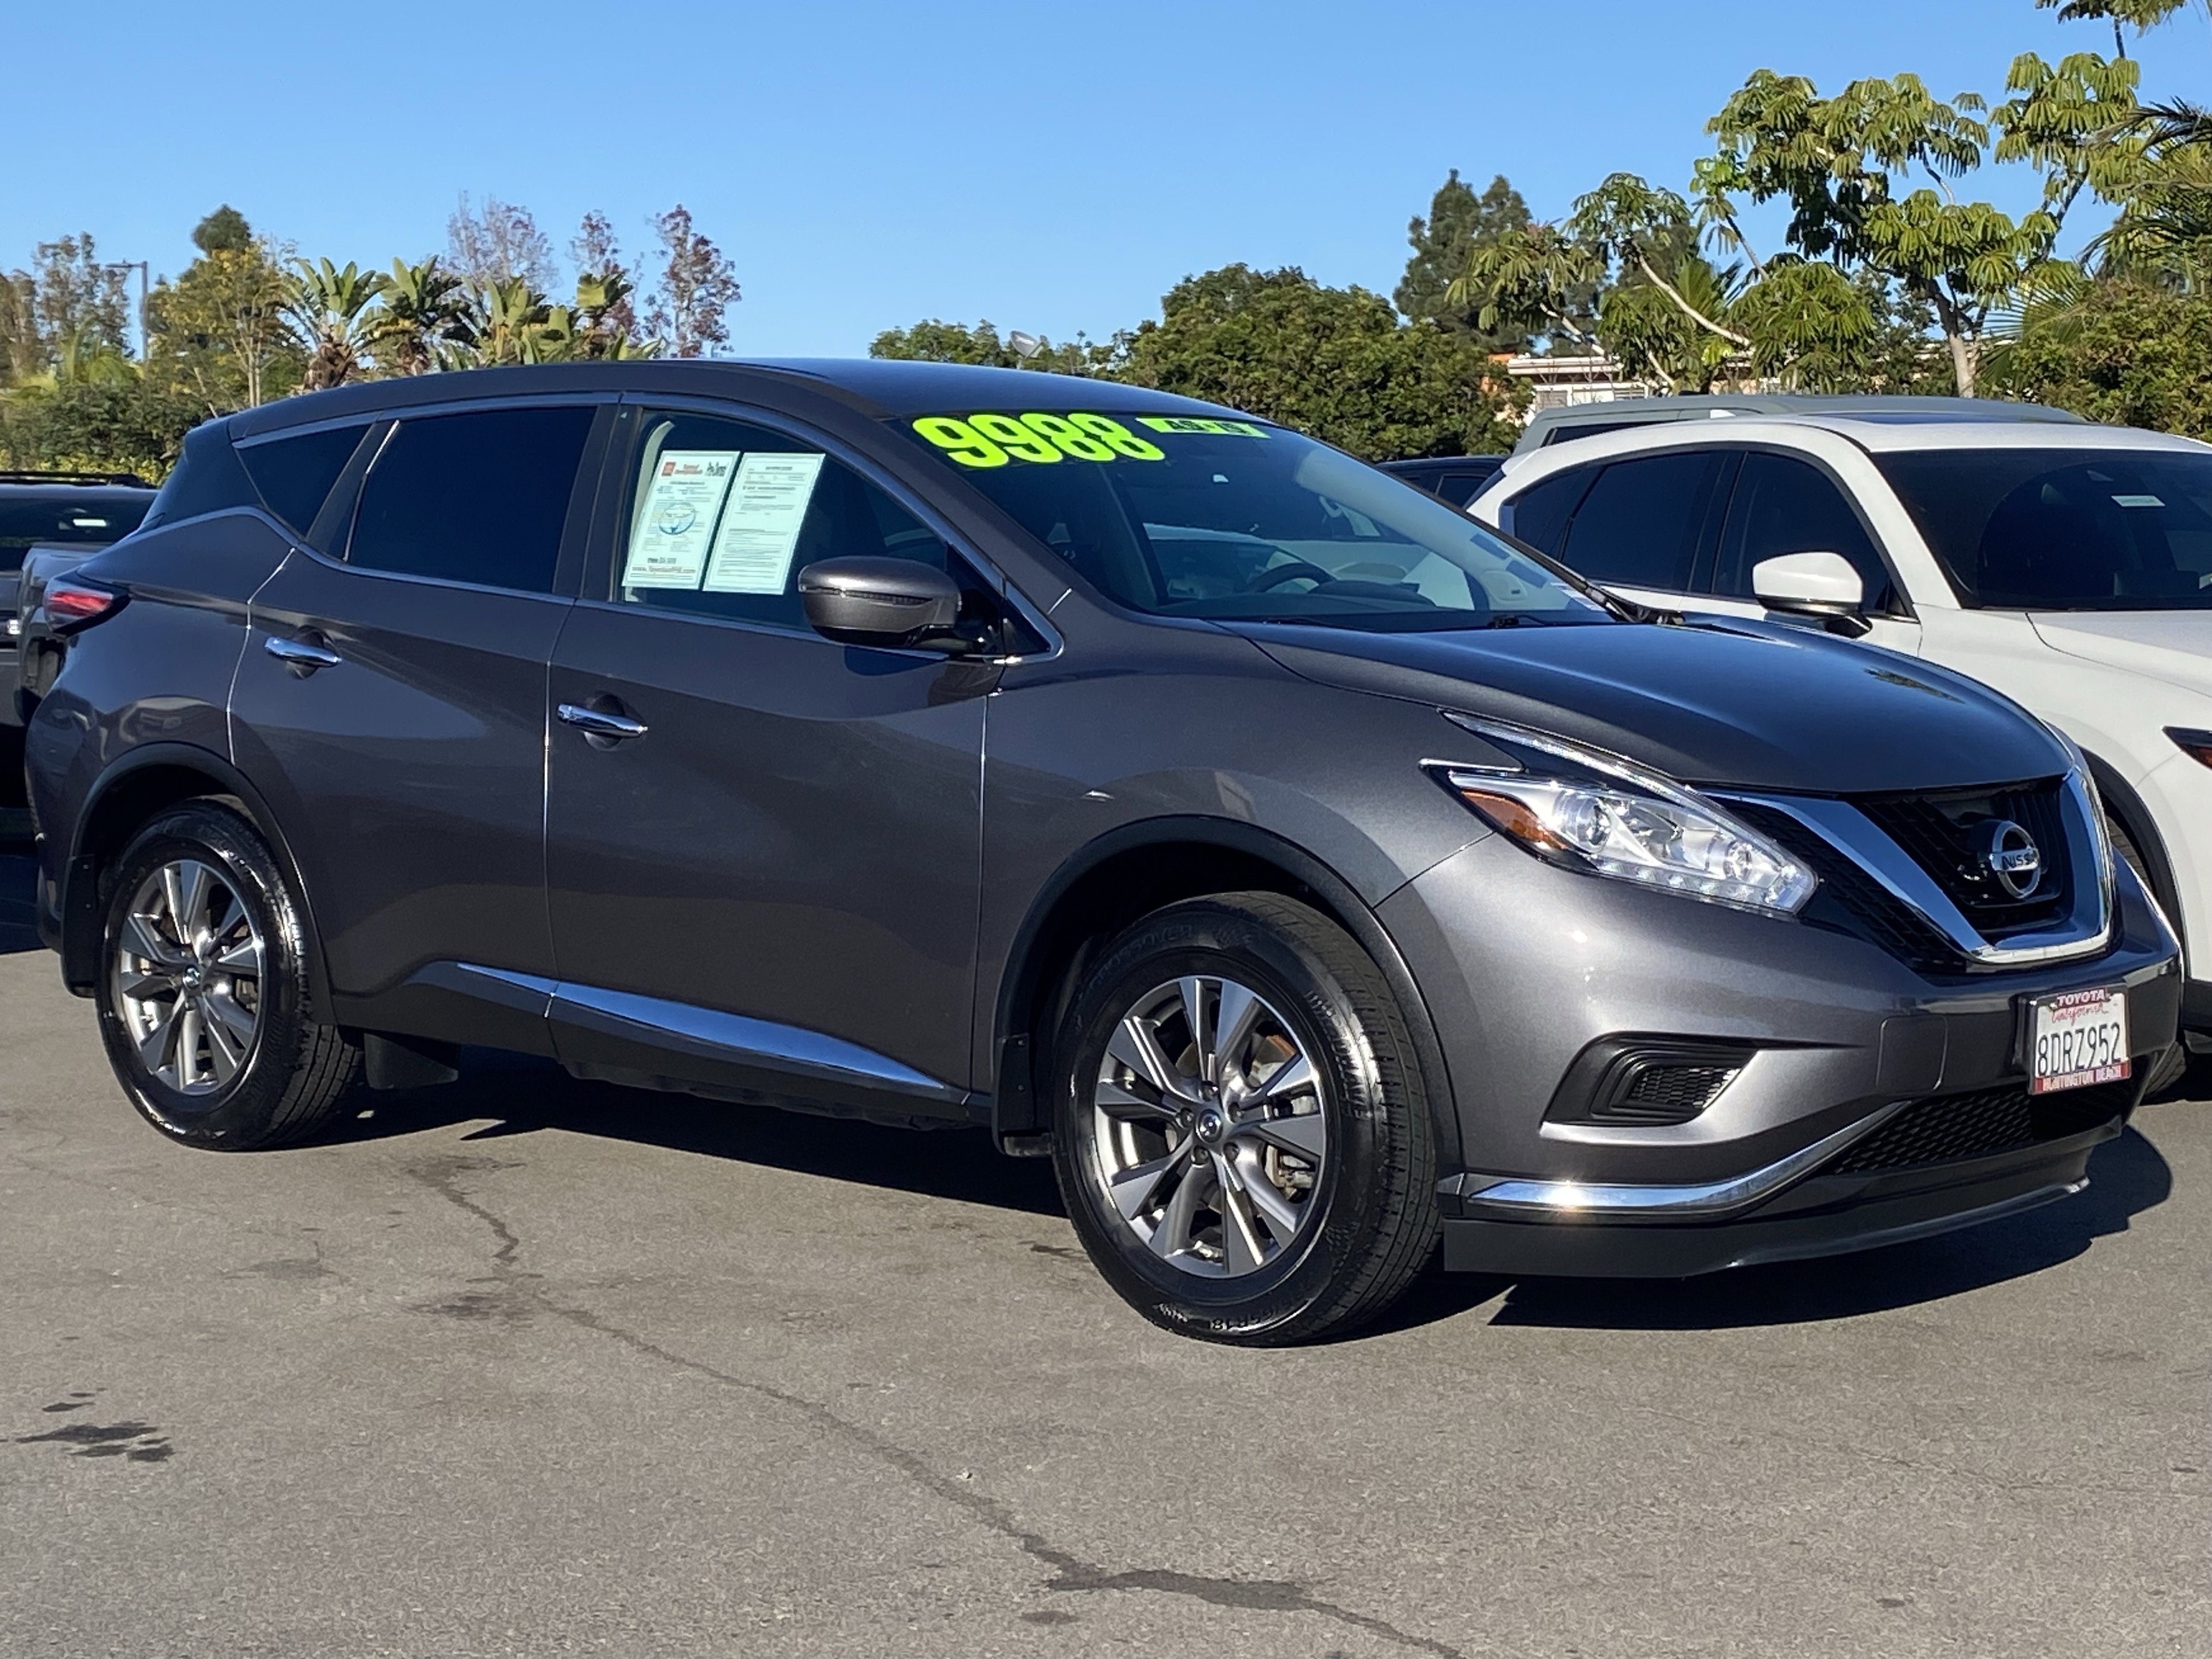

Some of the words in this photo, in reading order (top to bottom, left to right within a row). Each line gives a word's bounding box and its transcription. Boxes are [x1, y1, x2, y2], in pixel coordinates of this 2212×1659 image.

[912, 413, 1165, 467] 9988
[2057, 989, 2104, 1006] TOYOTA
[2038, 1022, 2121, 1076] 8DRZ952
